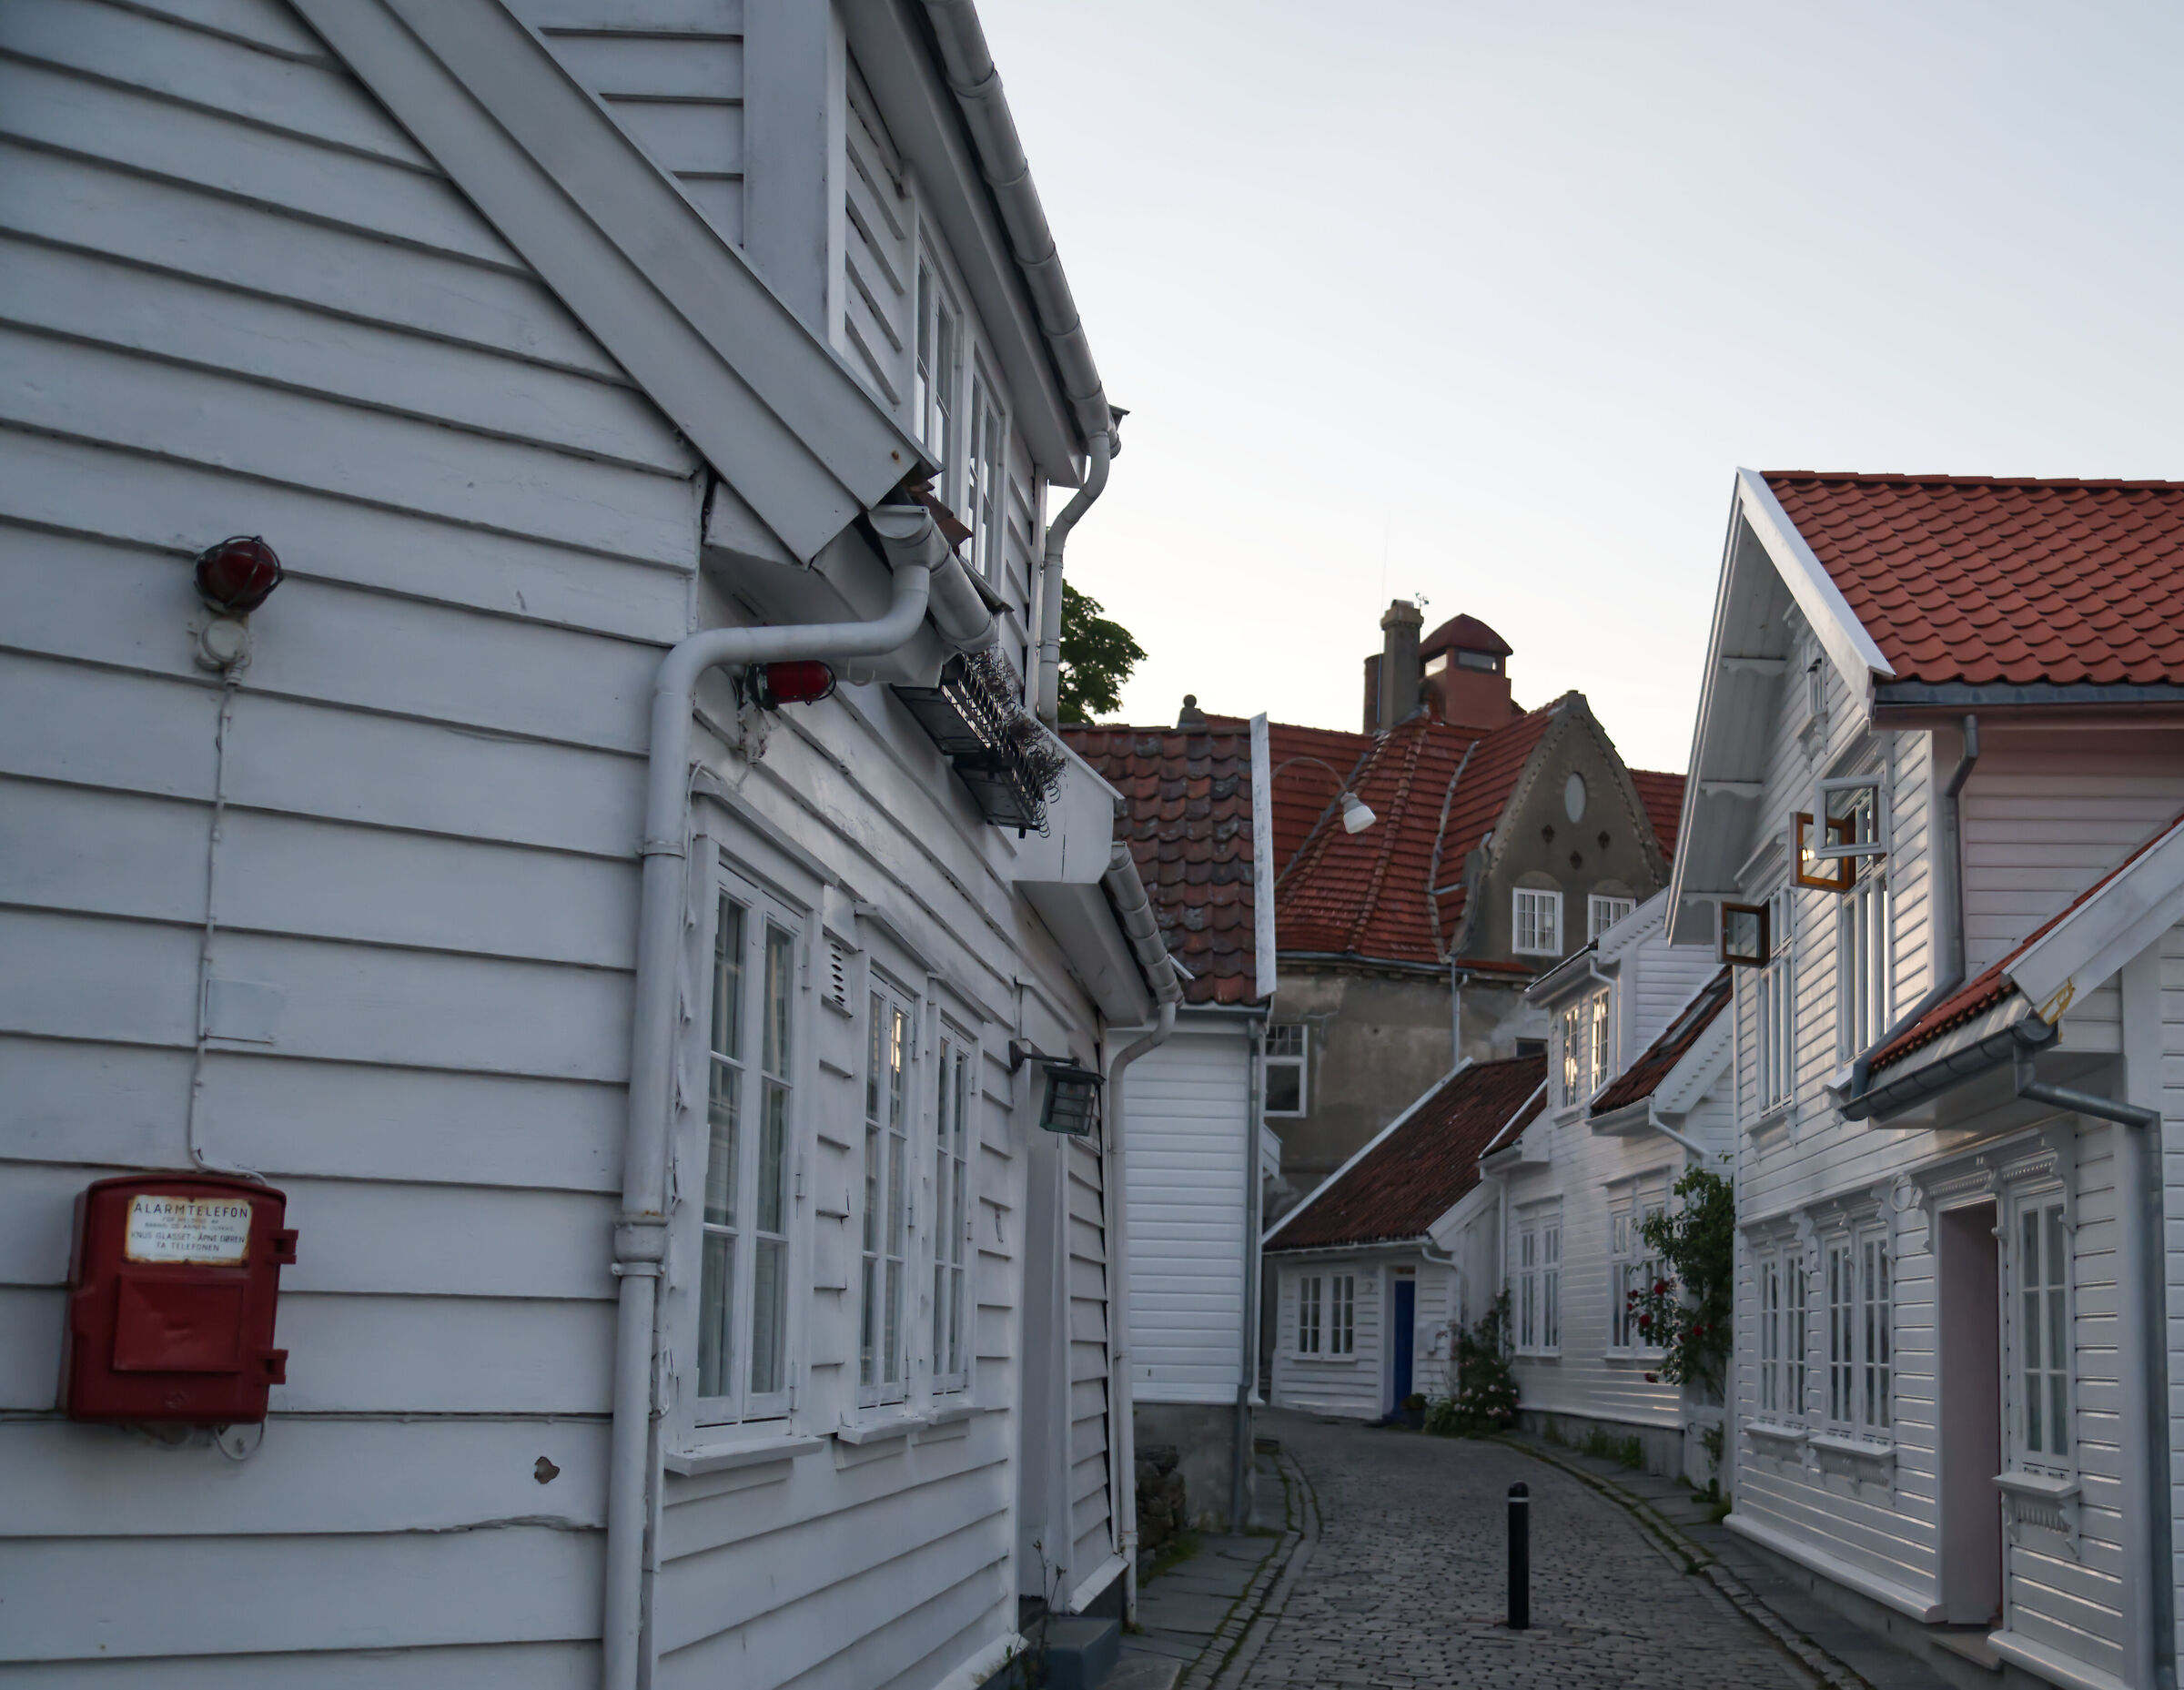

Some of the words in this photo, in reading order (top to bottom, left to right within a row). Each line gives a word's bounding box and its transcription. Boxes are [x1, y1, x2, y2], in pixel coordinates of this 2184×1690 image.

[133, 1201, 248, 1219] ALARMTELEFON
[130, 1230, 152, 1239] KNUS
[156, 1231, 191, 1240] GLASSET
[197, 1232, 217, 1242] ÅPNE
[171, 1241, 219, 1251] TELEFONEN
